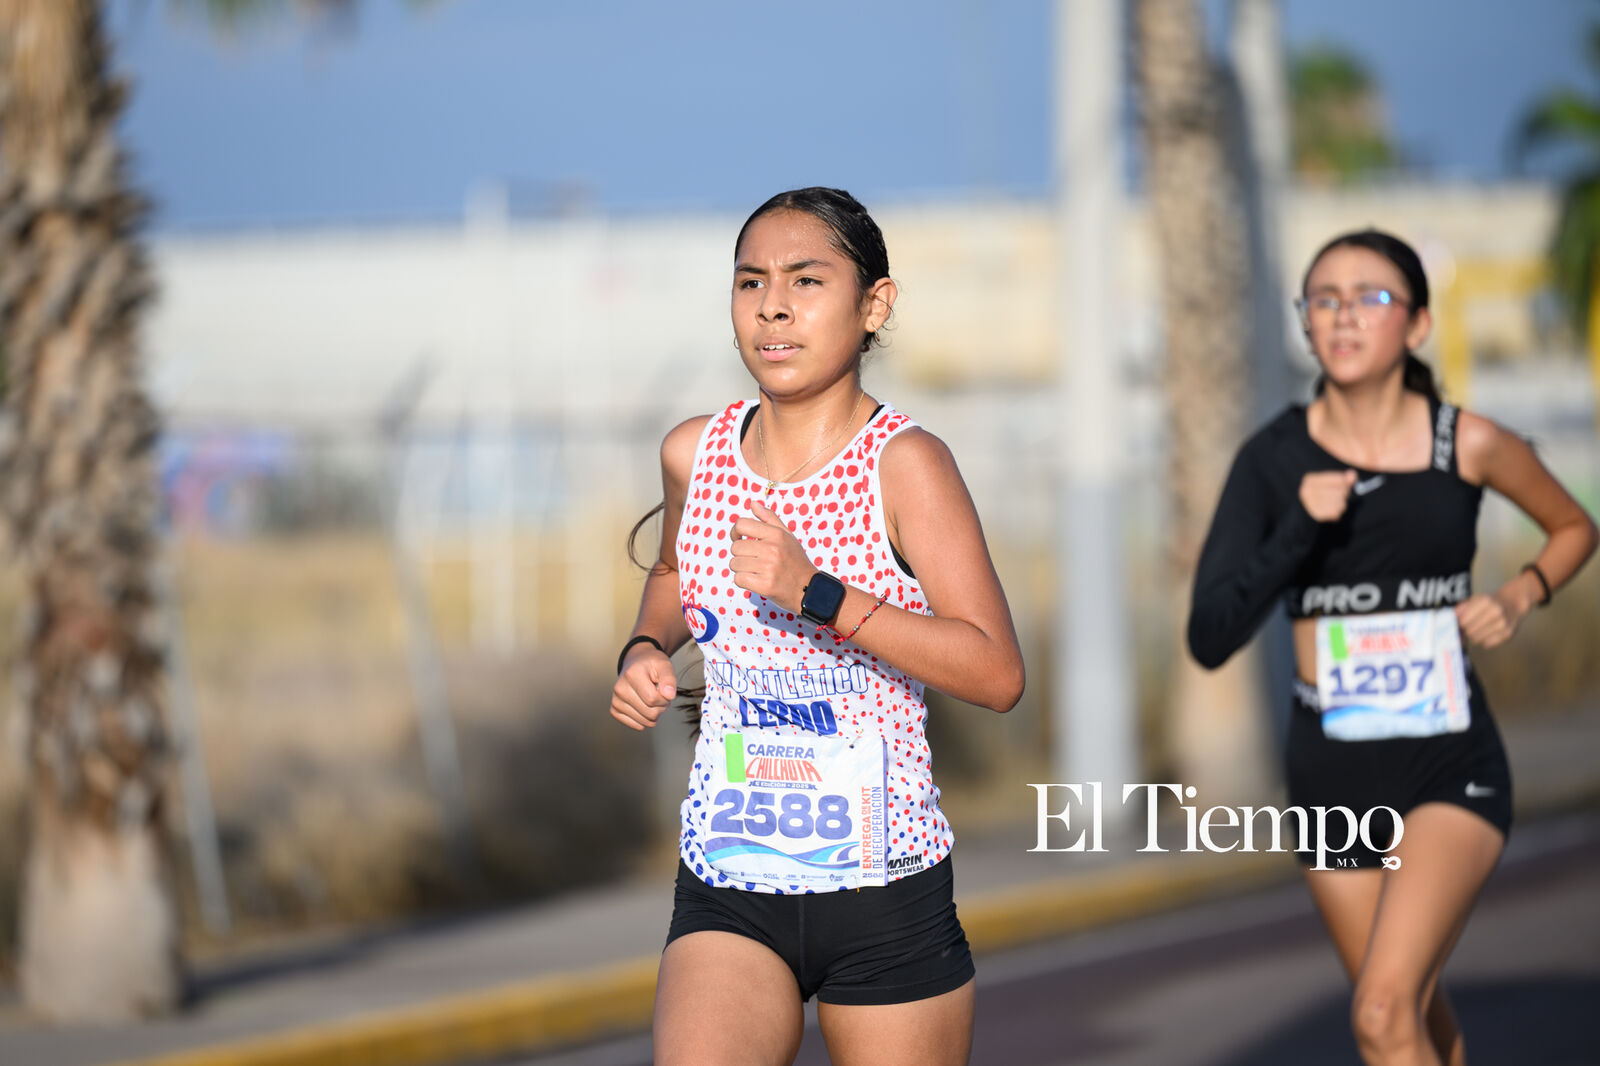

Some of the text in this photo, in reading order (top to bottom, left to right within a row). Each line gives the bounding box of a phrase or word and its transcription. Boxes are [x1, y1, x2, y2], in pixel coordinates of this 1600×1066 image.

[1302, 572, 1469, 615] PRO NIKE
[1329, 660, 1434, 697] 1297
[747, 743, 815, 759] CARRERA
[745, 757, 823, 782] CHILCHOTA
[862, 786, 871, 804] KIT
[711, 788, 853, 840] 2588
[862, 816, 872, 869] ENTREGA
[873, 856, 883, 869] DE
[888, 865, 924, 876] PORTSWEAR
